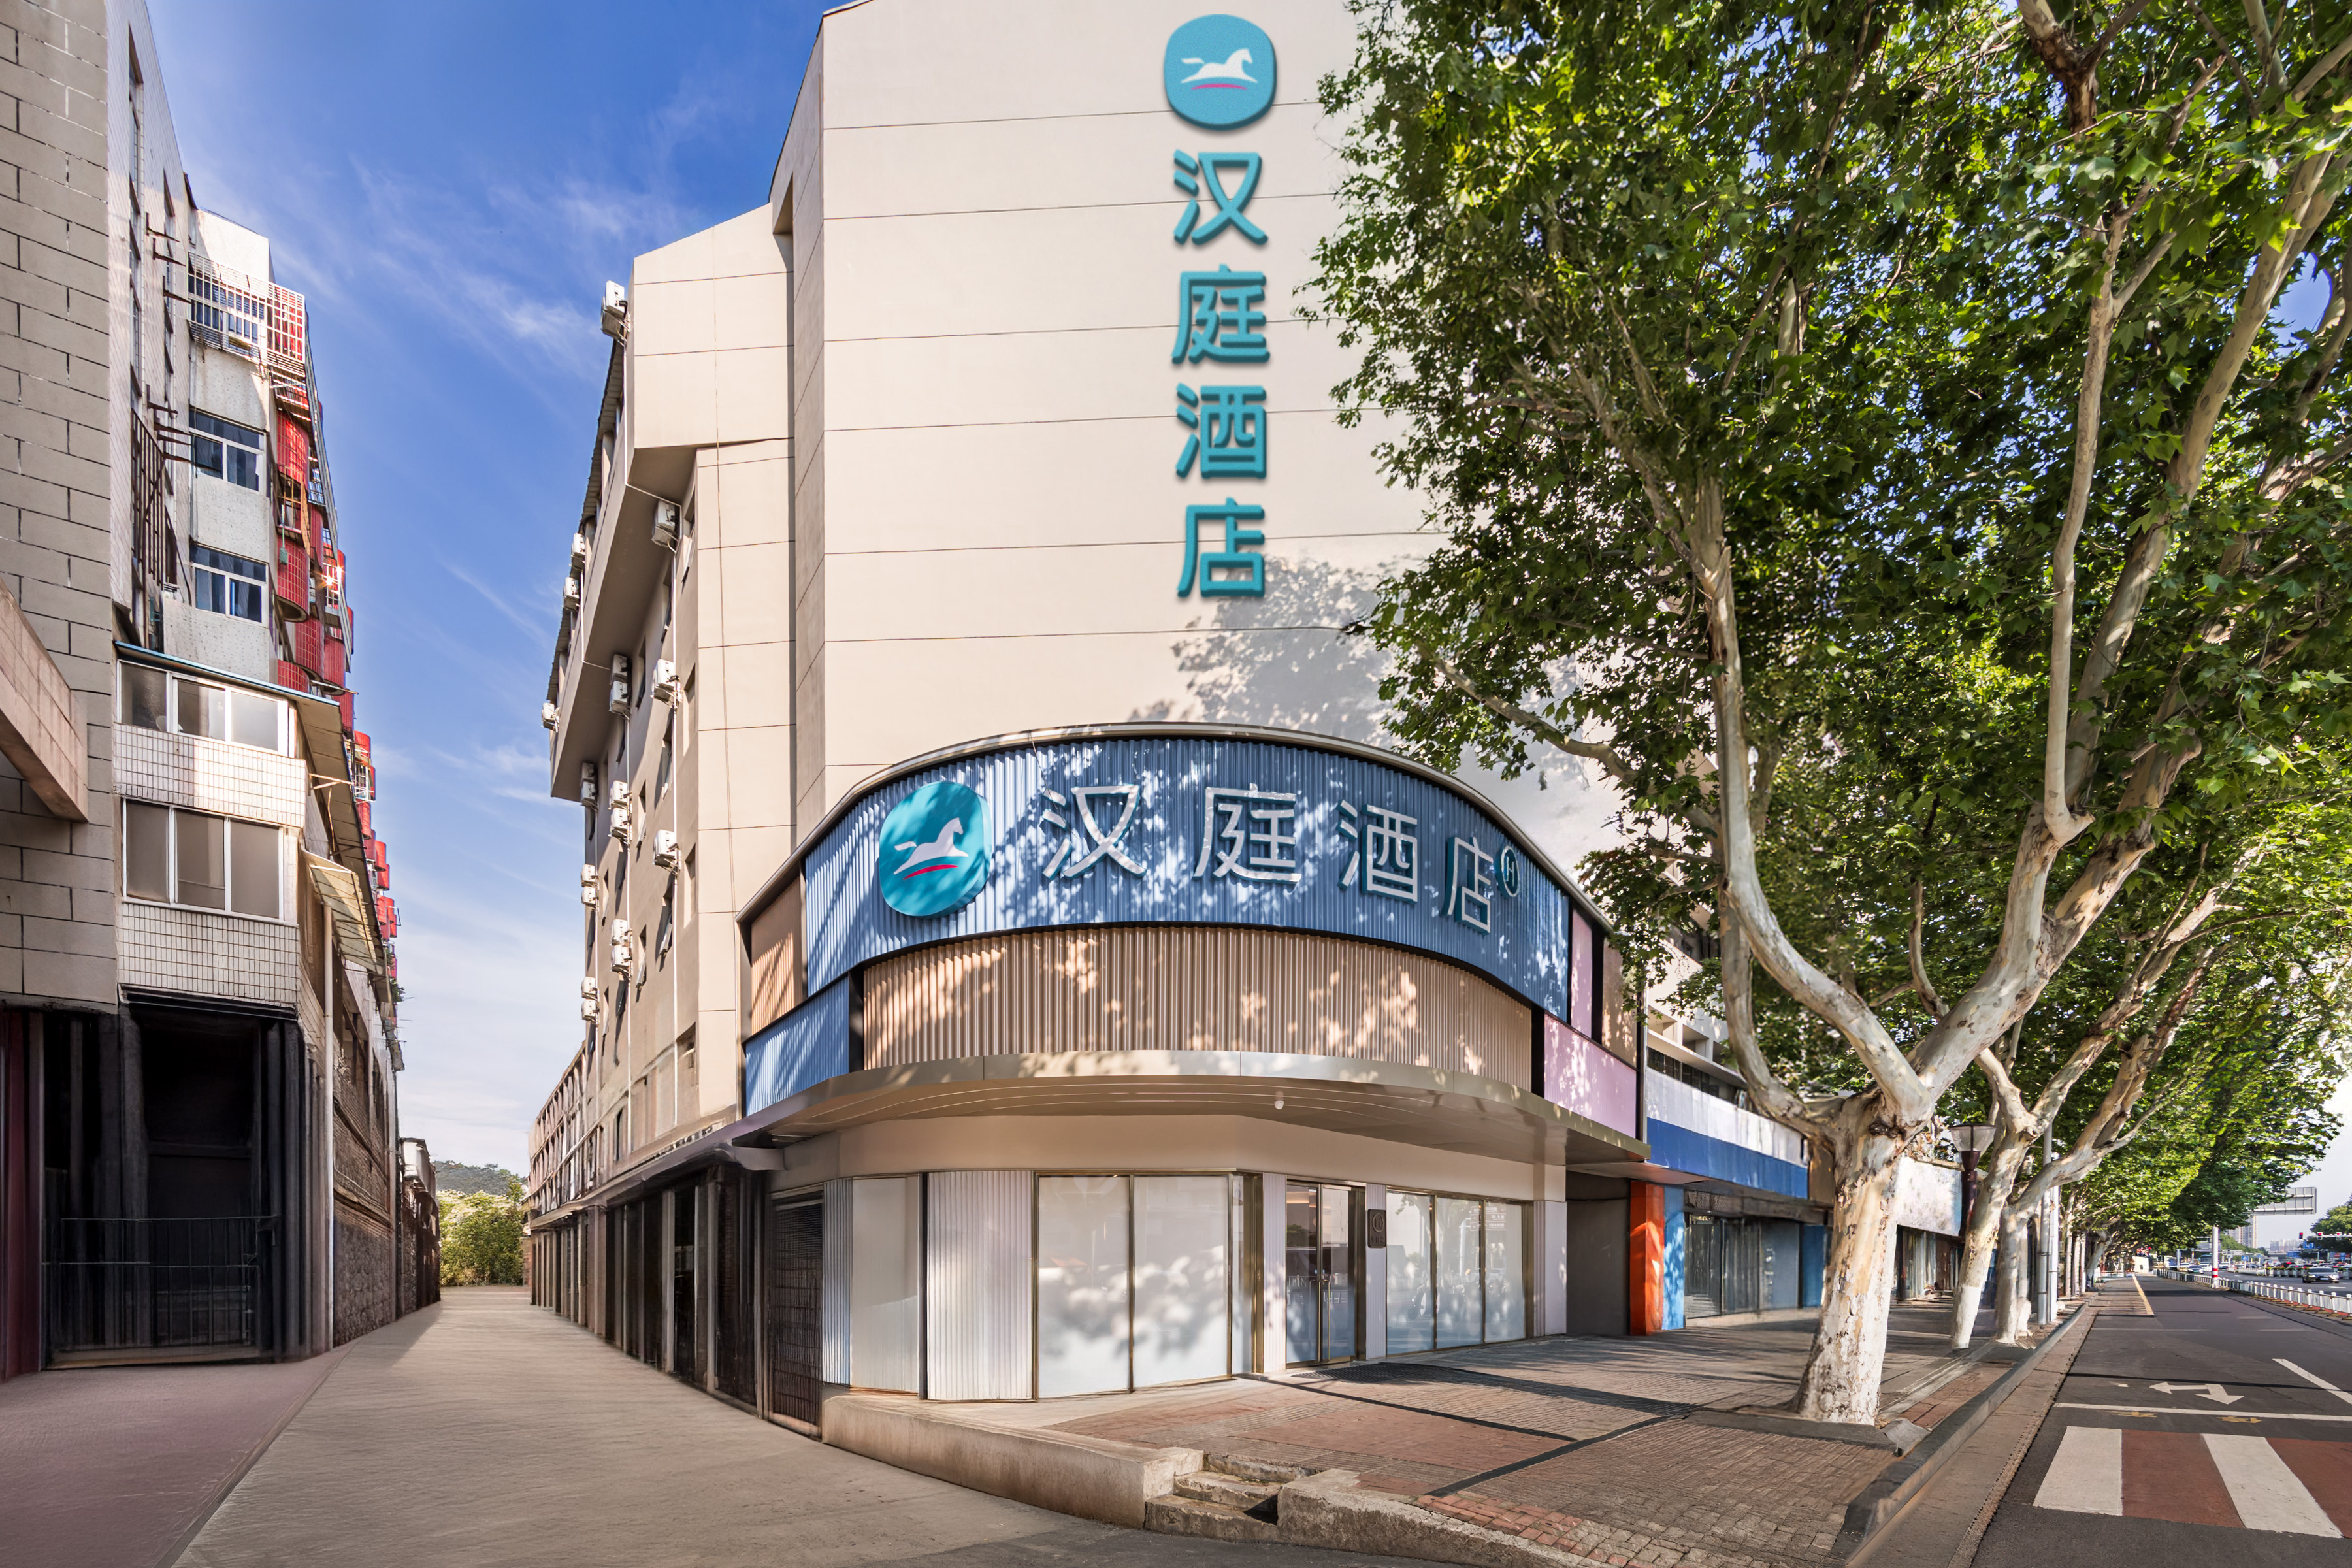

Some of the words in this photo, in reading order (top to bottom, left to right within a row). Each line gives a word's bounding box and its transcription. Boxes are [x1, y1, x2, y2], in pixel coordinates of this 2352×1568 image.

[1173, 149, 1270, 600] 汉庭酒店
[1041, 782, 1494, 934] 汉庭酒店
